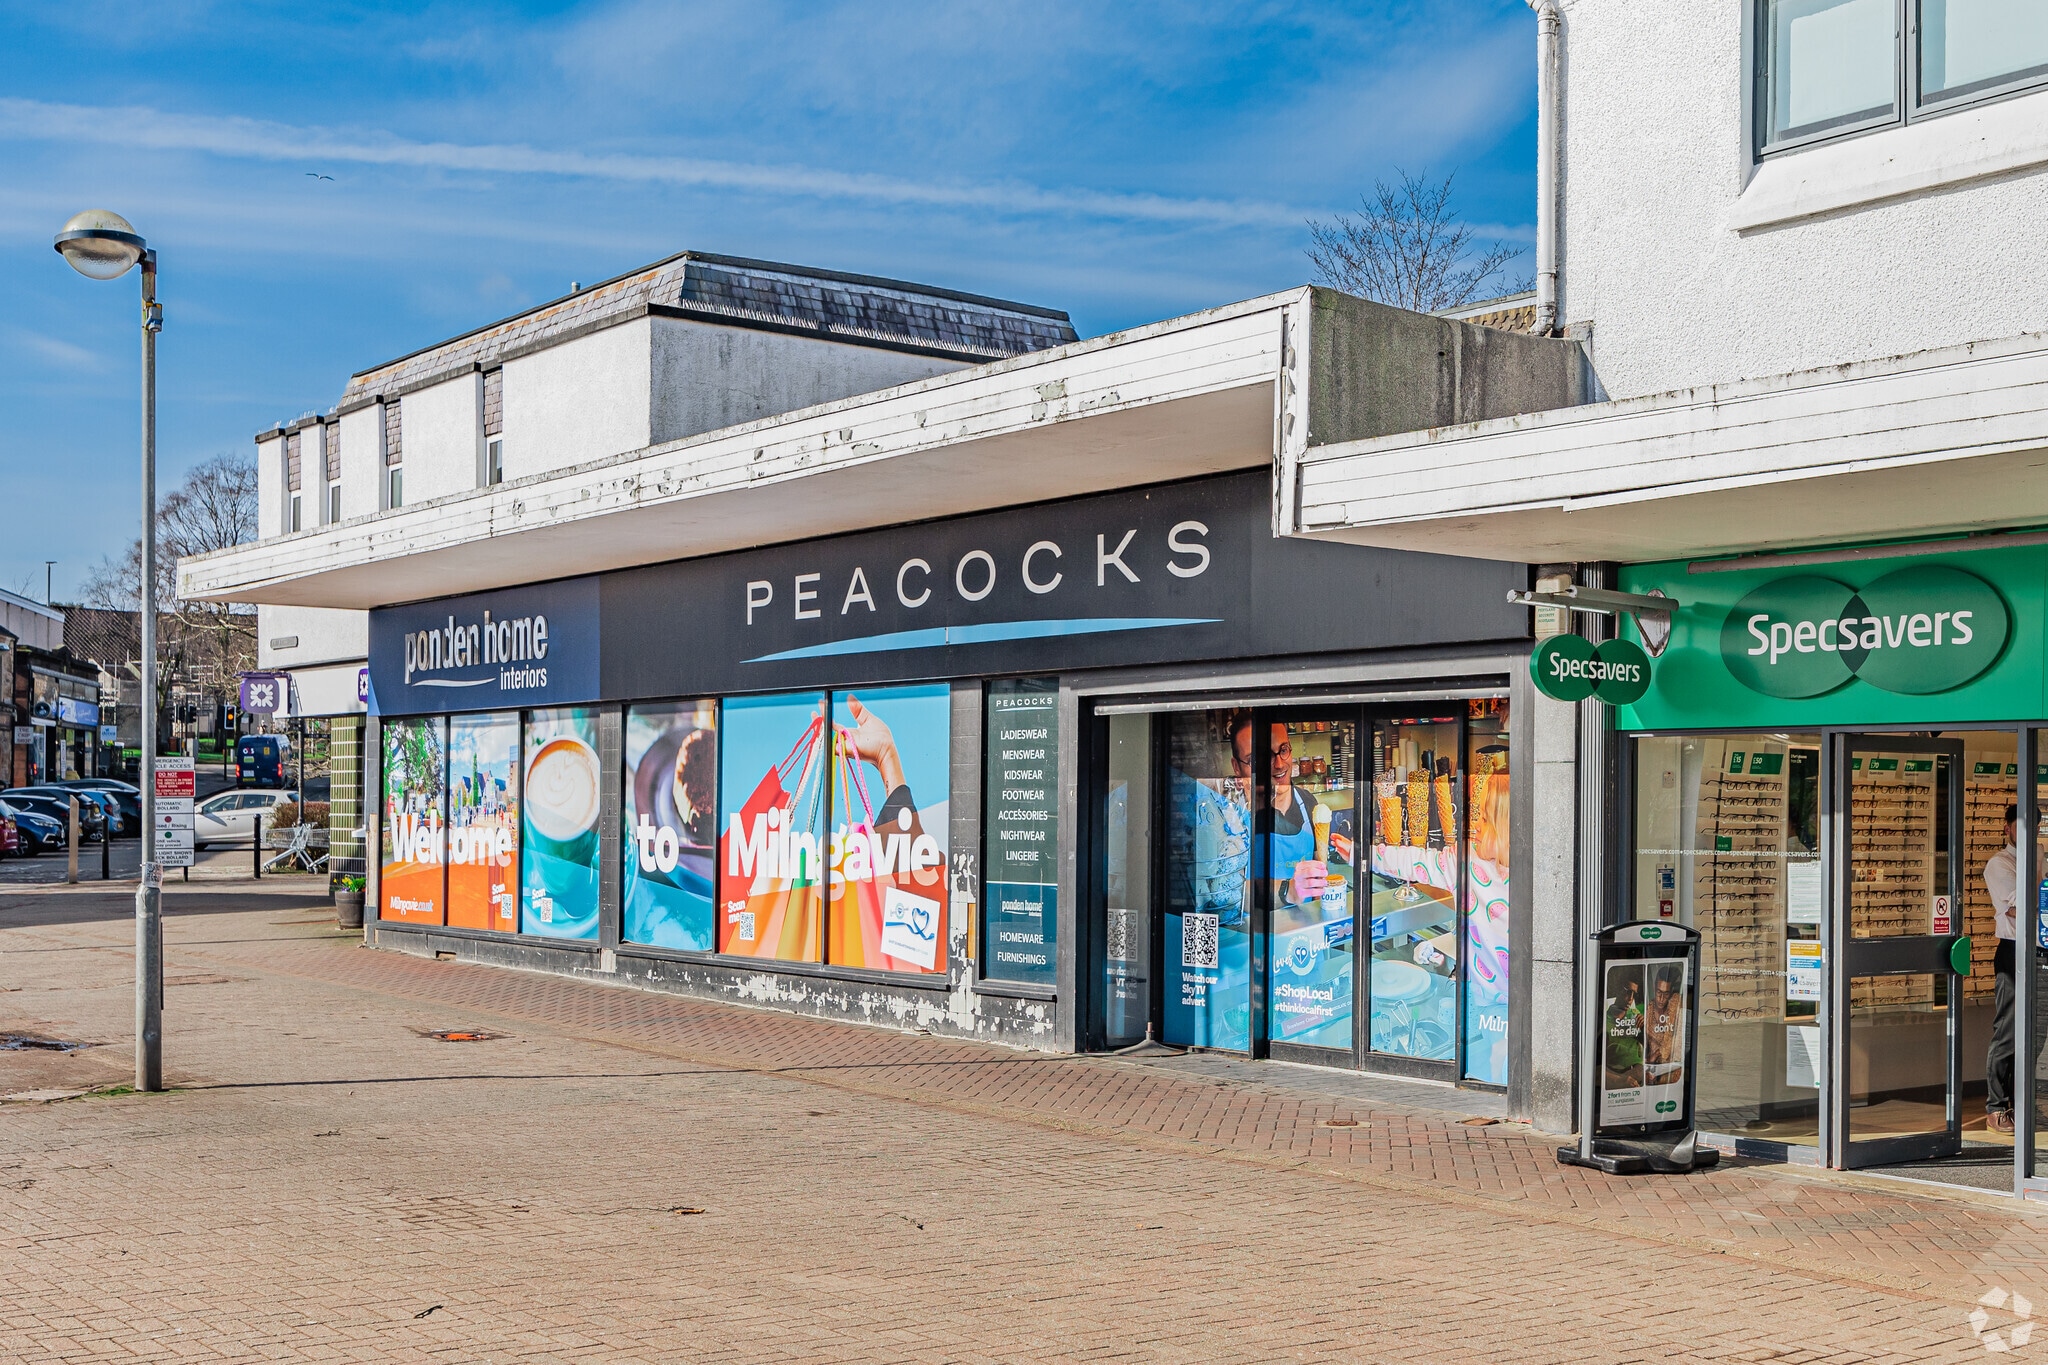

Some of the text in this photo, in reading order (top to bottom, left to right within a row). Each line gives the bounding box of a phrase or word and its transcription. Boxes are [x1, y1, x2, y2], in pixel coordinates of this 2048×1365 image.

[746, 520, 1211, 626] PEACOCKS
[1747, 610, 1974, 665] Specsavers
[404, 610, 548, 684] ponden home
[1549, 652, 1641, 682] Specsavers
[500, 665, 547, 690] interiors
[996, 697, 1053, 707] PEACOCKS
[1000, 729, 1047, 740] LADIESWEAR
[1002, 750, 1045, 760] MENSWEAR
[1004, 770, 1042, 780] KIDSWEAR
[1002, 790, 1044, 800] FOOTWEAR
[998, 810, 1048, 821] ACCESSORIES
[390, 809, 512, 867] Welcome
[1000, 830, 1045, 841] NIGHTWEAR
[637, 813, 679, 873] to
[728, 806, 940, 901] Milngavie
[1005, 850, 1039, 861] LINGERIE
[1638, 848, 1680, 856] specsavers.com
[1683, 848, 1726, 857] specsavers.com
[1729, 850, 1774, 858] specsavers.com
[492, 883, 506, 895] Scan
[531, 888, 546, 899] Scan
[727, 900, 746, 913] Scan
[1002, 900, 1042, 912] ponden home
[1000, 932, 1043, 945] HOMEWARE
[1309, 935, 1334, 960] Local
[997, 952, 1047, 965] FURNISHINGS
[1273, 954, 1294, 975] Loves
[1181, 972, 1218, 985] Watch our
[1181, 984, 1206, 996] Sky TV
[1274, 984, 1333, 1001] #ShopLocal
[1181, 996, 1206, 1007] advert
[1274, 1002, 1333, 1017] #thinklocalfirst
[1615, 1017, 1636, 1028] Seize
[1659, 1014, 1670, 1024] Or
[1610, 1026, 1640, 1038] the day
[1654, 1023, 1675, 1034] don't
